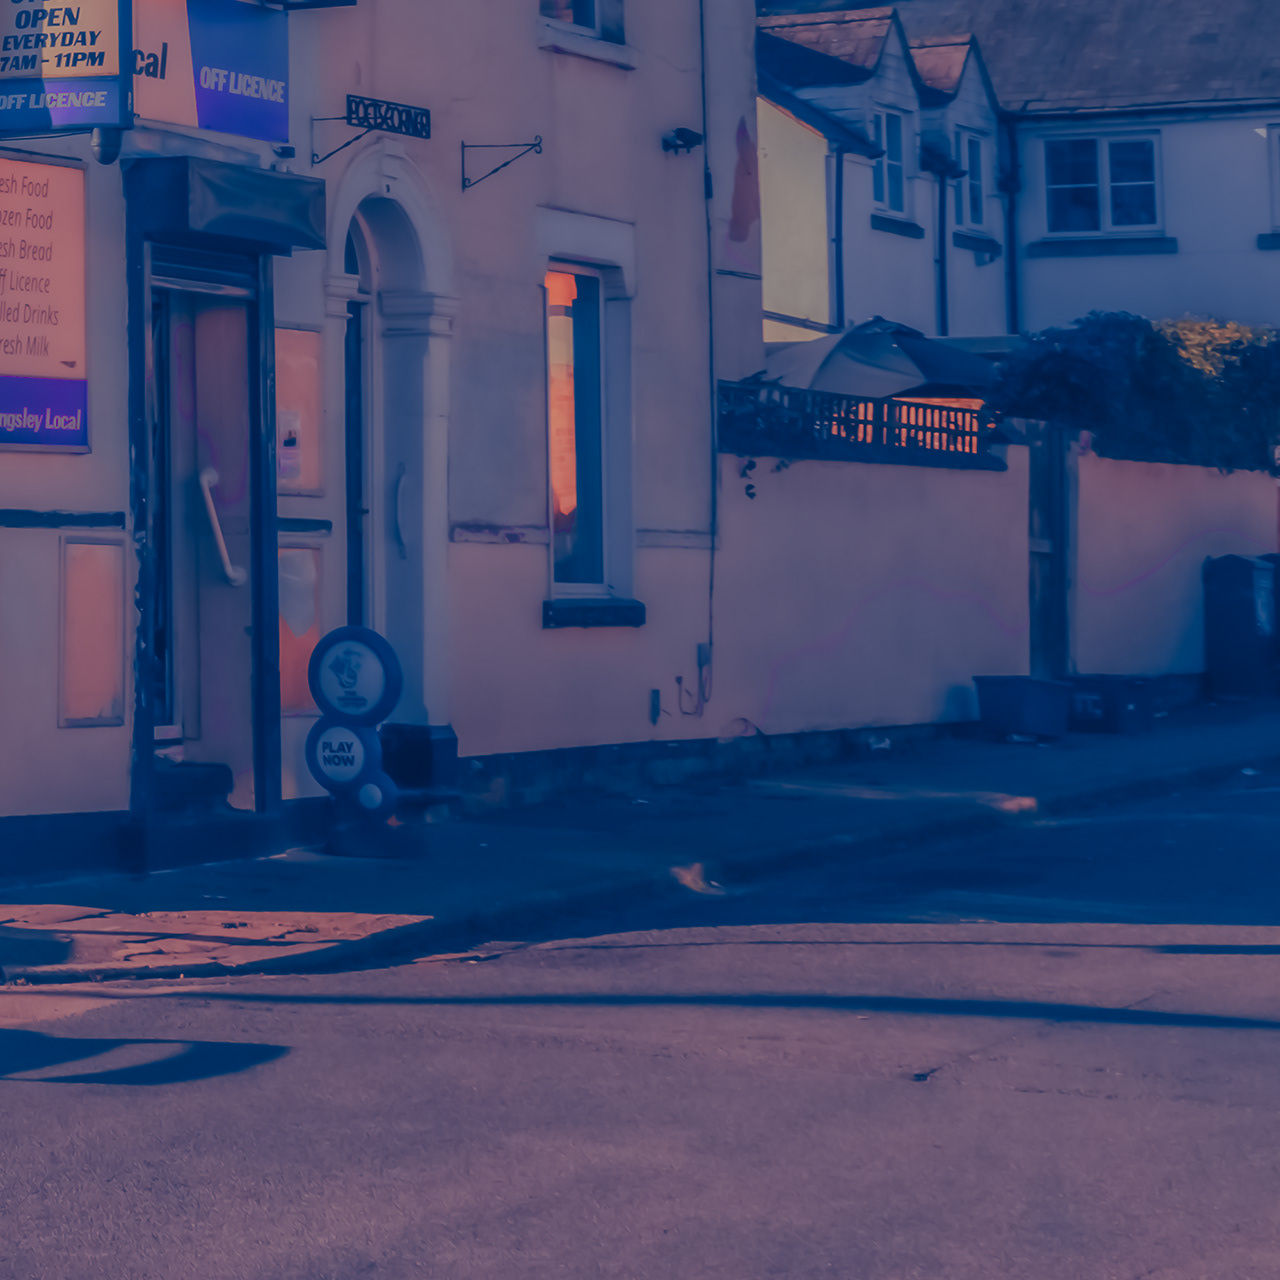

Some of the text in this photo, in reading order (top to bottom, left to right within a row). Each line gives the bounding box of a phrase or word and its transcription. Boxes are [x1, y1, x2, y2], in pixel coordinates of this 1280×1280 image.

[15, 7, 80, 29] OPEN
[2, 31, 102, 51] EVERYDAY
[0, 54, 37, 72] 7AM
[54, 52, 105, 68] 11PM
[132, 42, 168, 80] cal
[200, 66, 286, 103] OFF LICENCE
[29, 91, 107, 109] LICENCE
[21, 176, 49, 198] Food
[26, 208, 53, 230] Food
[19, 239, 52, 261] Bread
[10, 270, 50, 293] Licence
[24, 303, 59, 326] Drinks
[26, 335, 49, 357] Milk
[45, 409, 81, 430] Local
[322, 742, 354, 754] PLAY
[323, 754, 355, 766] NOW
